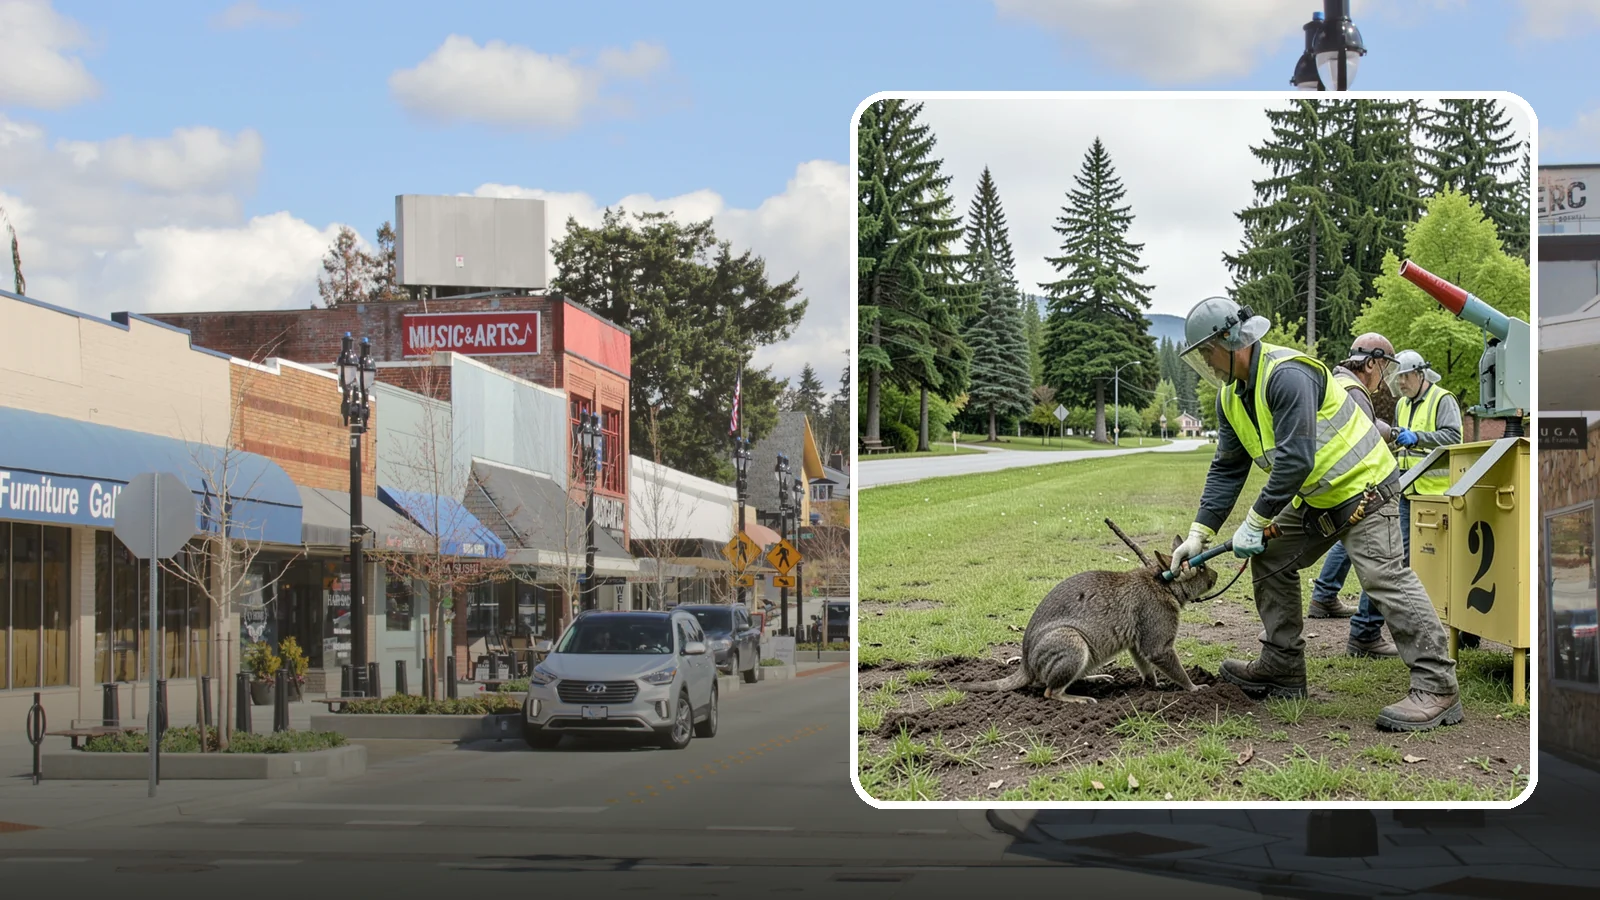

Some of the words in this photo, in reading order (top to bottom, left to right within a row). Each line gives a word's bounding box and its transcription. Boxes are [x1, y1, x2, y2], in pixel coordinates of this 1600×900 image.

[408, 322, 520, 350] MUSIC&ARTS
[1540, 427, 1578, 437] UGA
[0, 471, 79, 515] Furniture
[89, 482, 121, 519] Gal
[453, 563, 479, 574] SUSHI
[1466, 520, 1496, 615] 2
